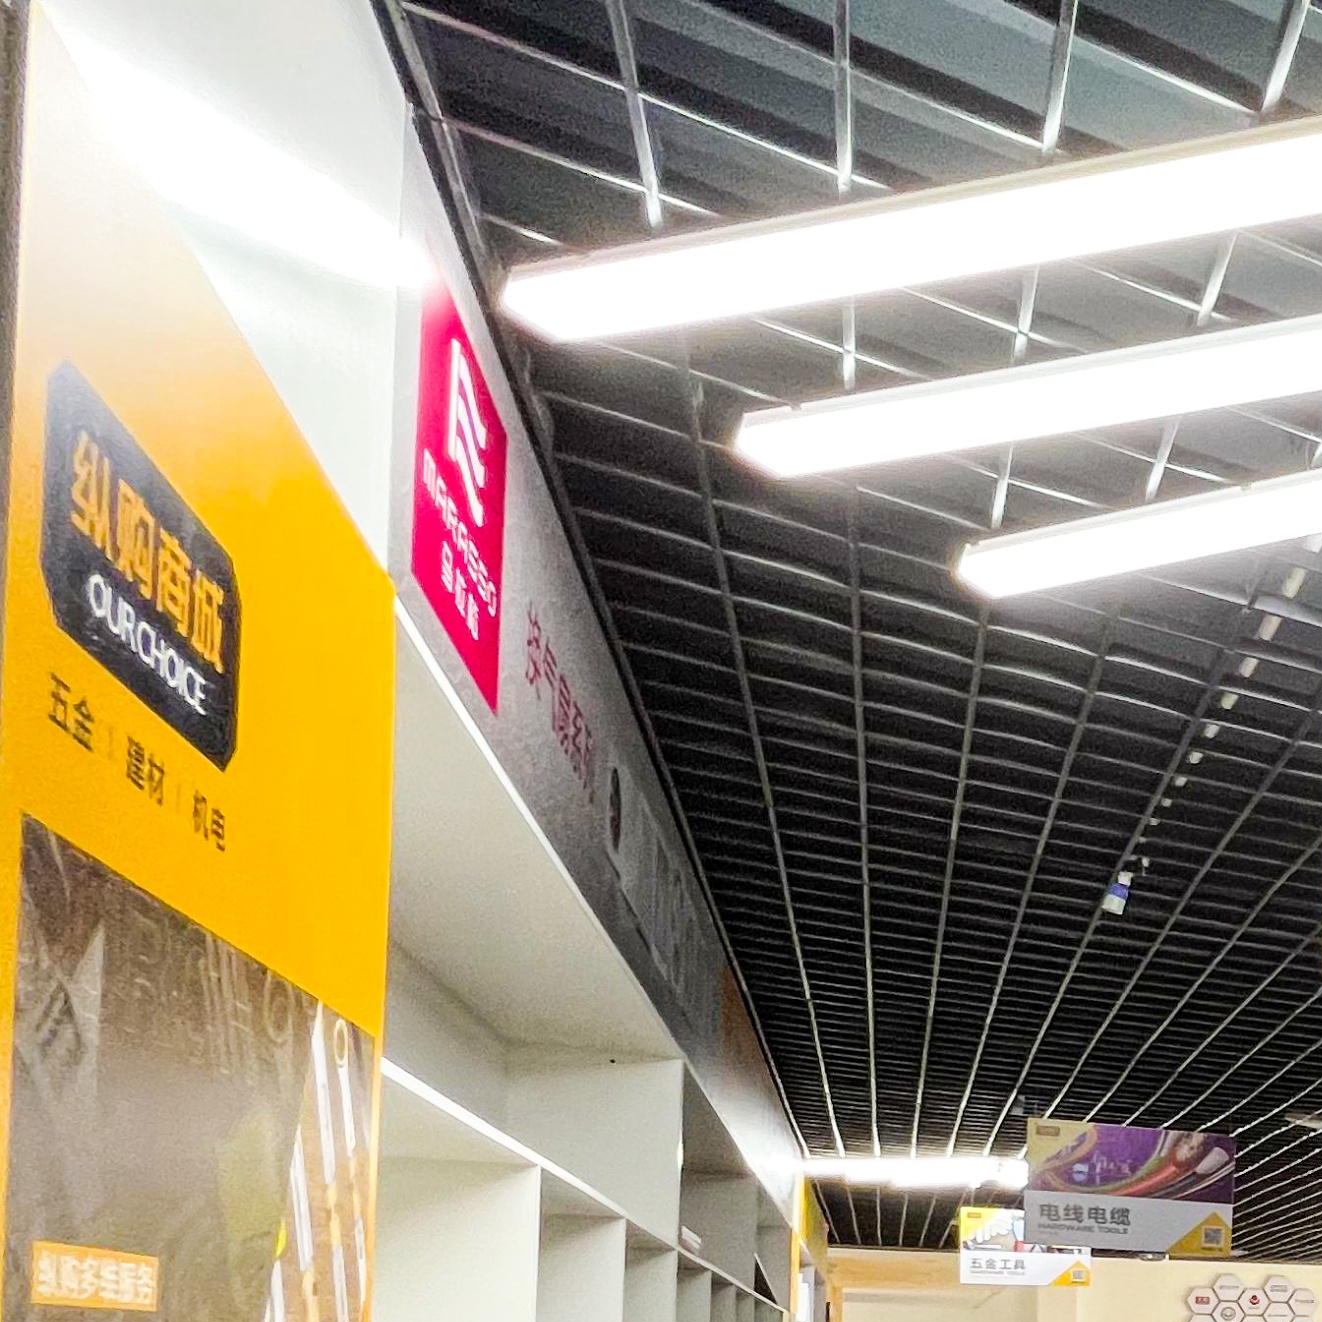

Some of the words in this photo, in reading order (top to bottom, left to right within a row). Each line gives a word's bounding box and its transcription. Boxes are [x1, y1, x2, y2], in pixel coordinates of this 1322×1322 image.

[49, 672, 94, 752] 五金
[1040, 1203, 1131, 1226] 电线电缆
[971, 1258, 1025, 1270] 五金工具
